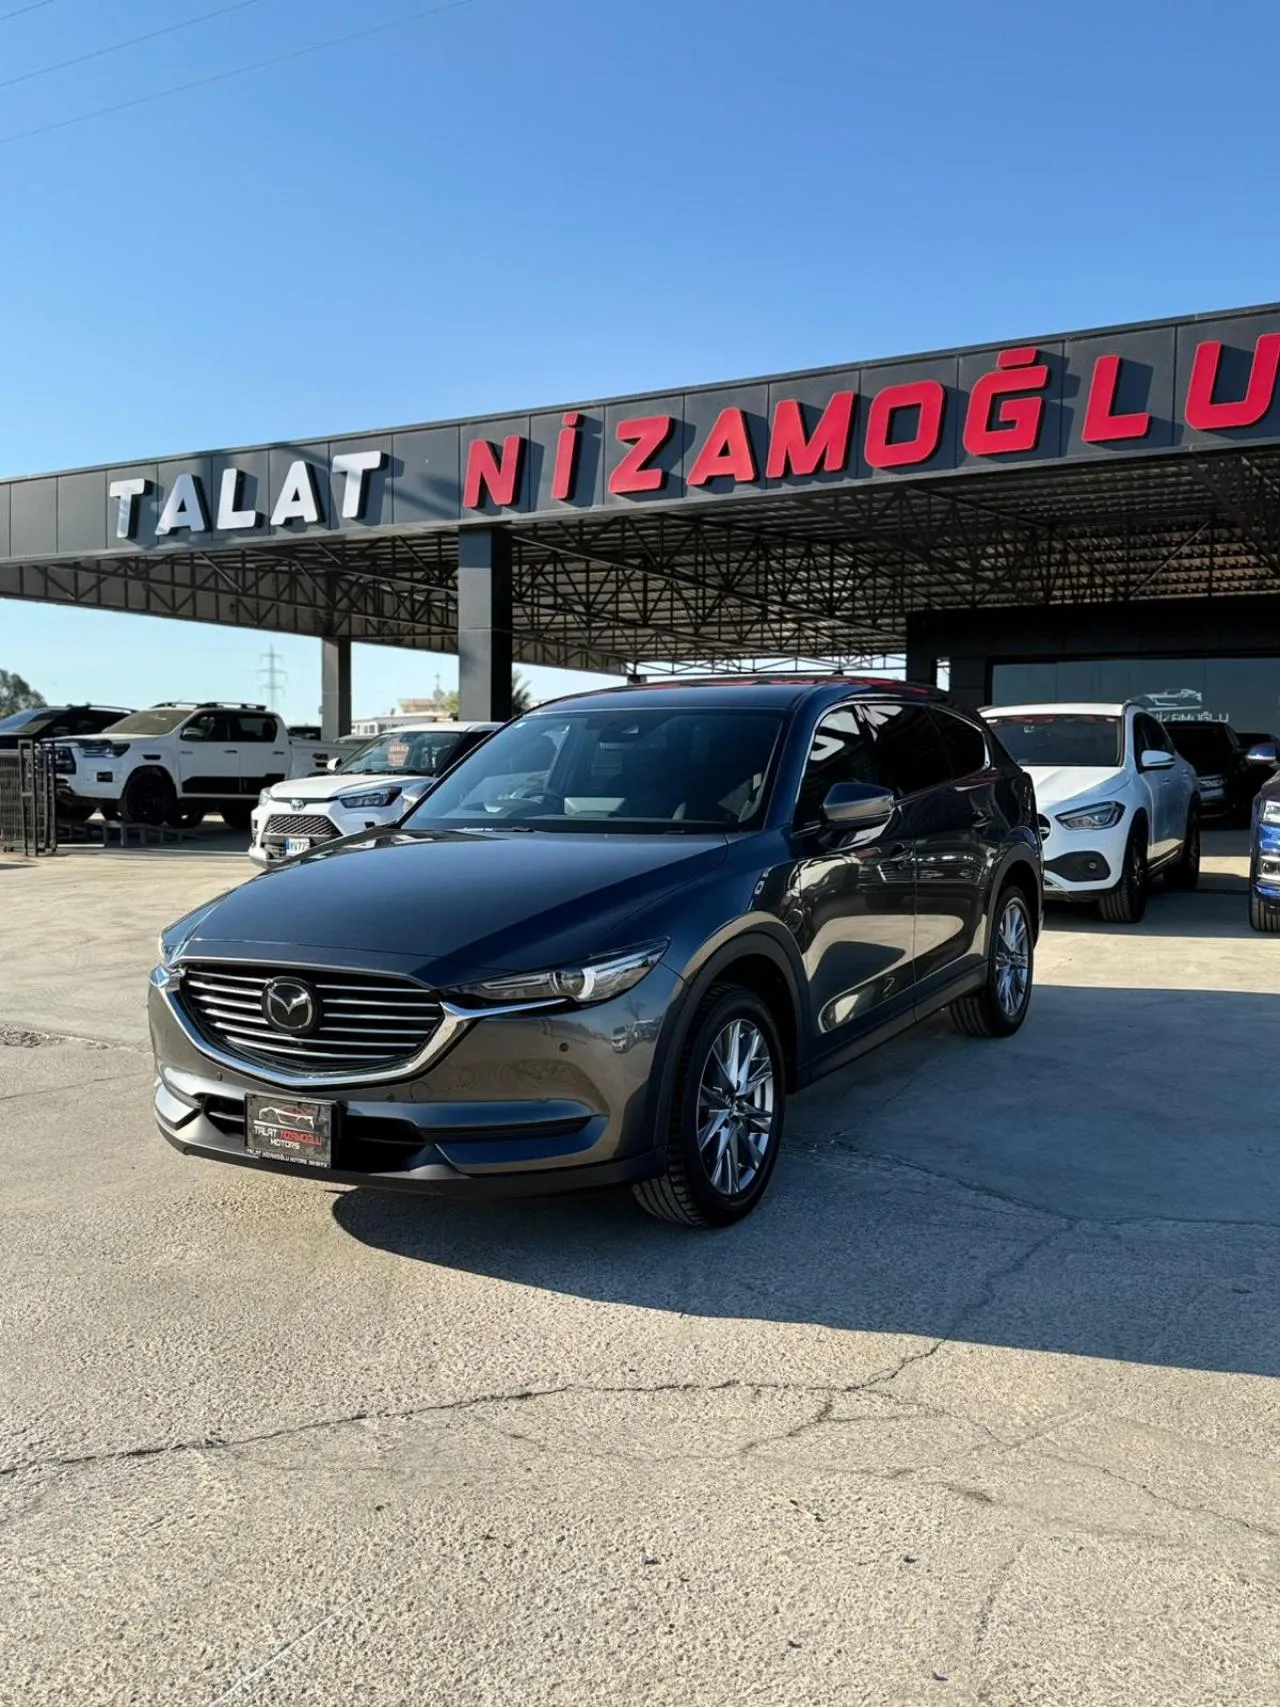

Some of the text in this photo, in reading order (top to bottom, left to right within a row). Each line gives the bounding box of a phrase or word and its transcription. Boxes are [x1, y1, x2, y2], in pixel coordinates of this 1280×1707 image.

[109, 332, 1280, 539] TALAT NİZAMOĞLU
[254, 1126, 278, 1137] TALAT
[270, 1138, 300, 1149] MOTORS
